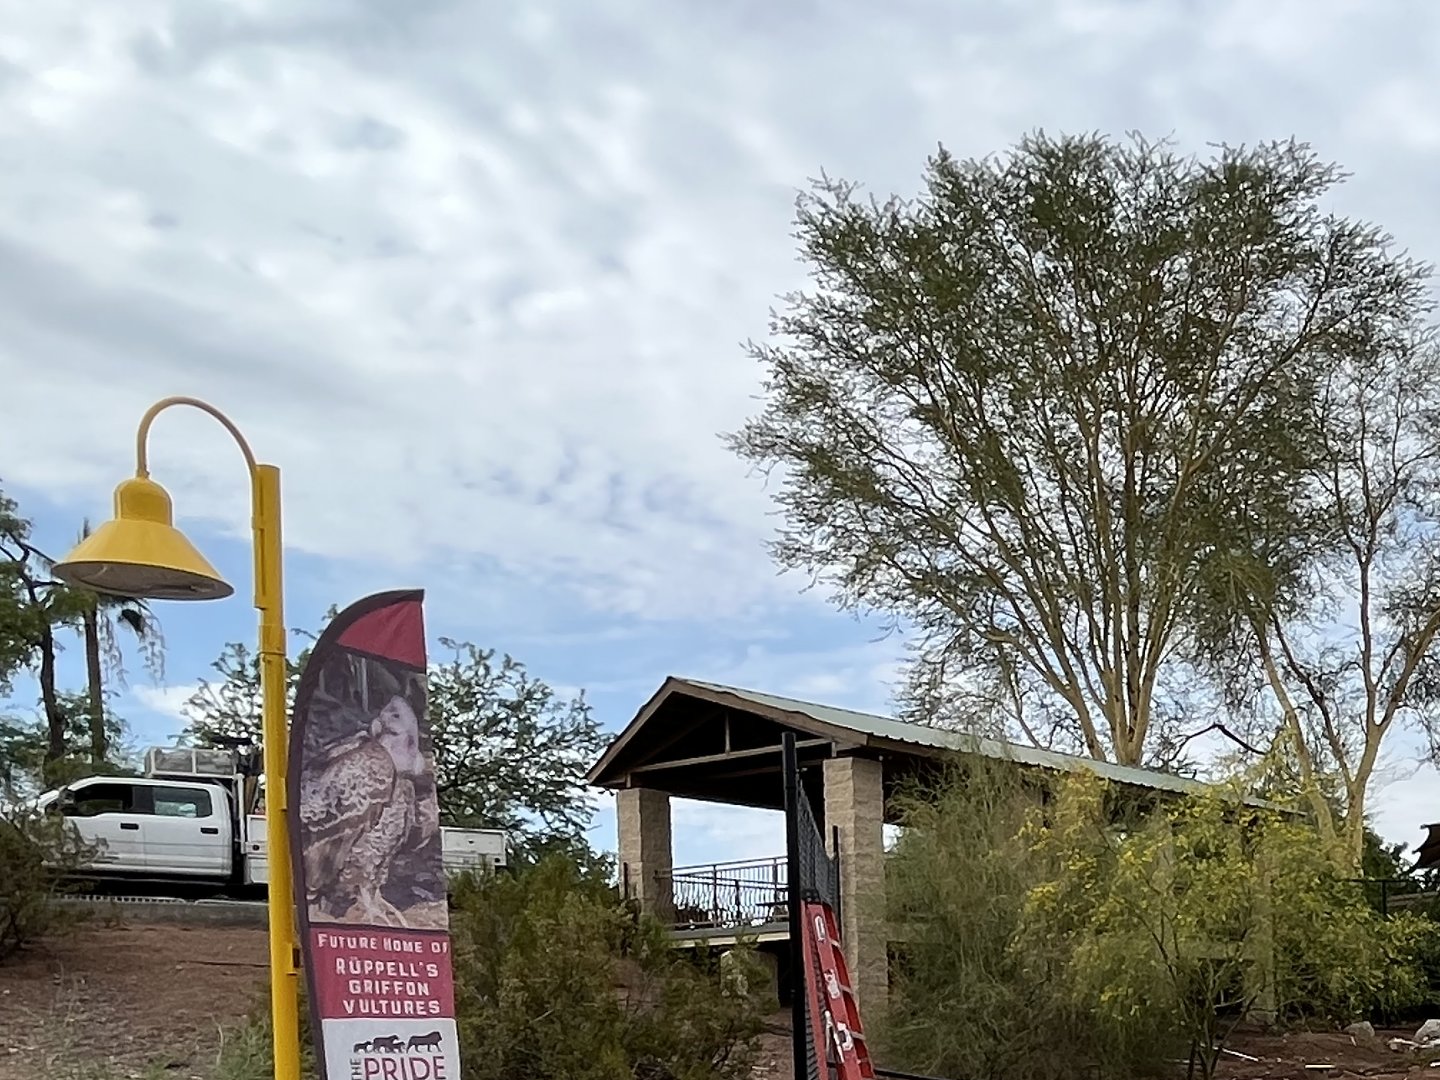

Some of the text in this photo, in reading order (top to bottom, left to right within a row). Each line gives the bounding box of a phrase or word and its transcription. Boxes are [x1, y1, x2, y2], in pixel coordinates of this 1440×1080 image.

[318, 934, 377, 950] FUTURE
[383, 938, 423, 953] HOME
[336, 956, 439, 977] RÜPPELL'S
[349, 980, 430, 996] GRIFFON
[343, 999, 440, 1015] VULTURES
